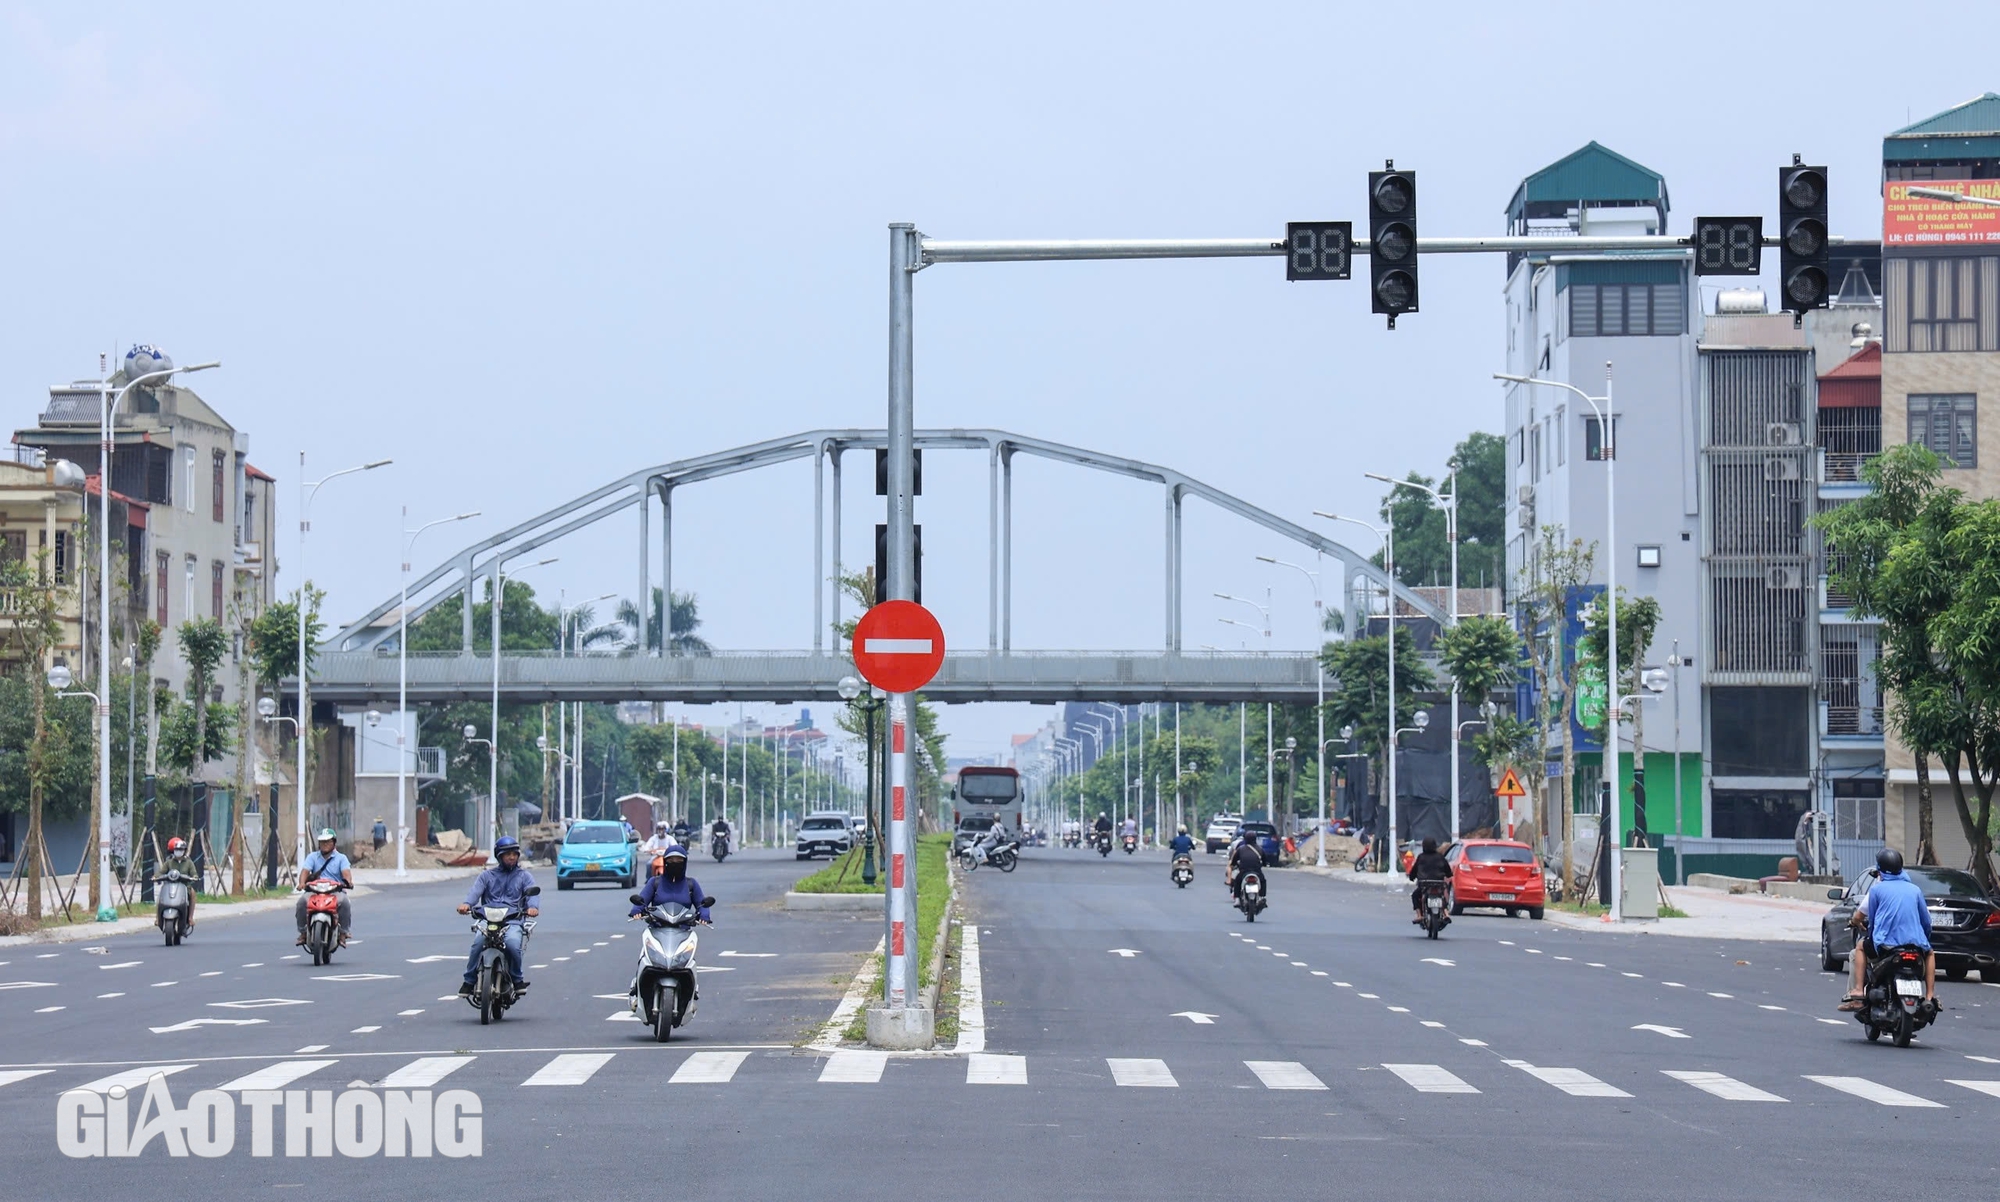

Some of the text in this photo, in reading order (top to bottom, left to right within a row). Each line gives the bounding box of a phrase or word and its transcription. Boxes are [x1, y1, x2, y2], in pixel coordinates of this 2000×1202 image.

[1970, 181, 2000, 198] NHÀ
[1896, 213, 1915, 221] NHÀ
[1889, 233, 1902, 242] LH:
[1904, 232, 1914, 242] (C
[1916, 232, 1943, 242] HÙNG)
[1945, 232, 1966, 241] 0945
[1969, 232, 1983, 240] 111
[1293, 230, 1344, 272] 88
[1701, 224, 1754, 268] 88
